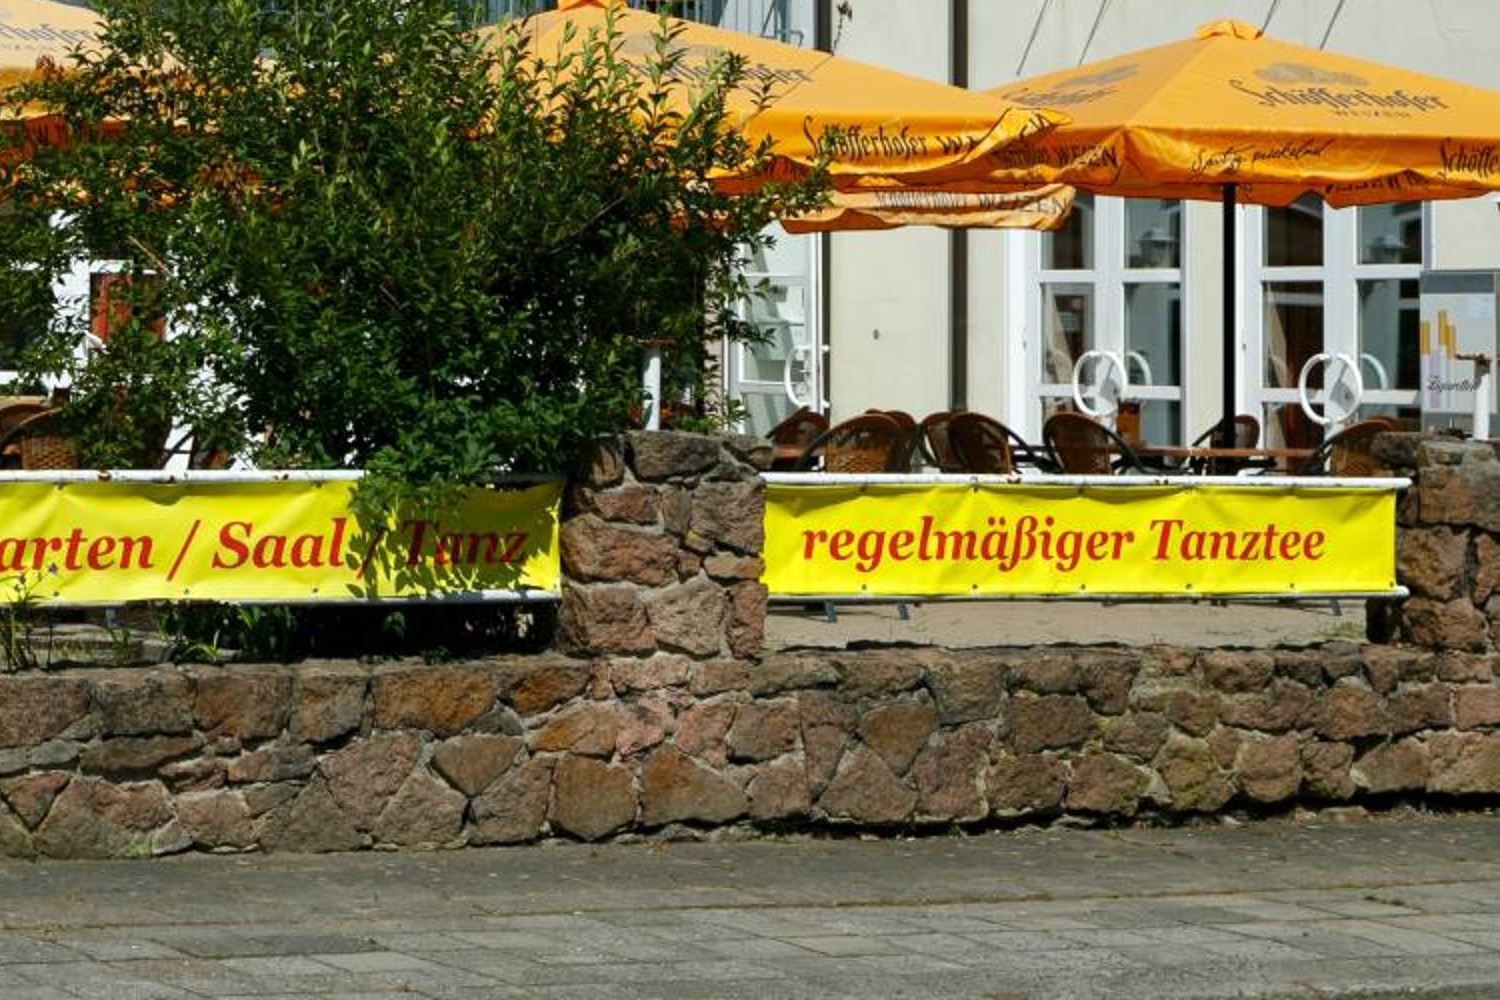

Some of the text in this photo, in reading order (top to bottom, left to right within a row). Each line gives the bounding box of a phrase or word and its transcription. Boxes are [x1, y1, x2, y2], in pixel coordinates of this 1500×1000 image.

[167, 520, 201, 581] /
[212, 519, 347, 569] Saal
[404, 519, 529, 568] Tanz
[803, 515, 1326, 572] regelmäßiger Tanztee
